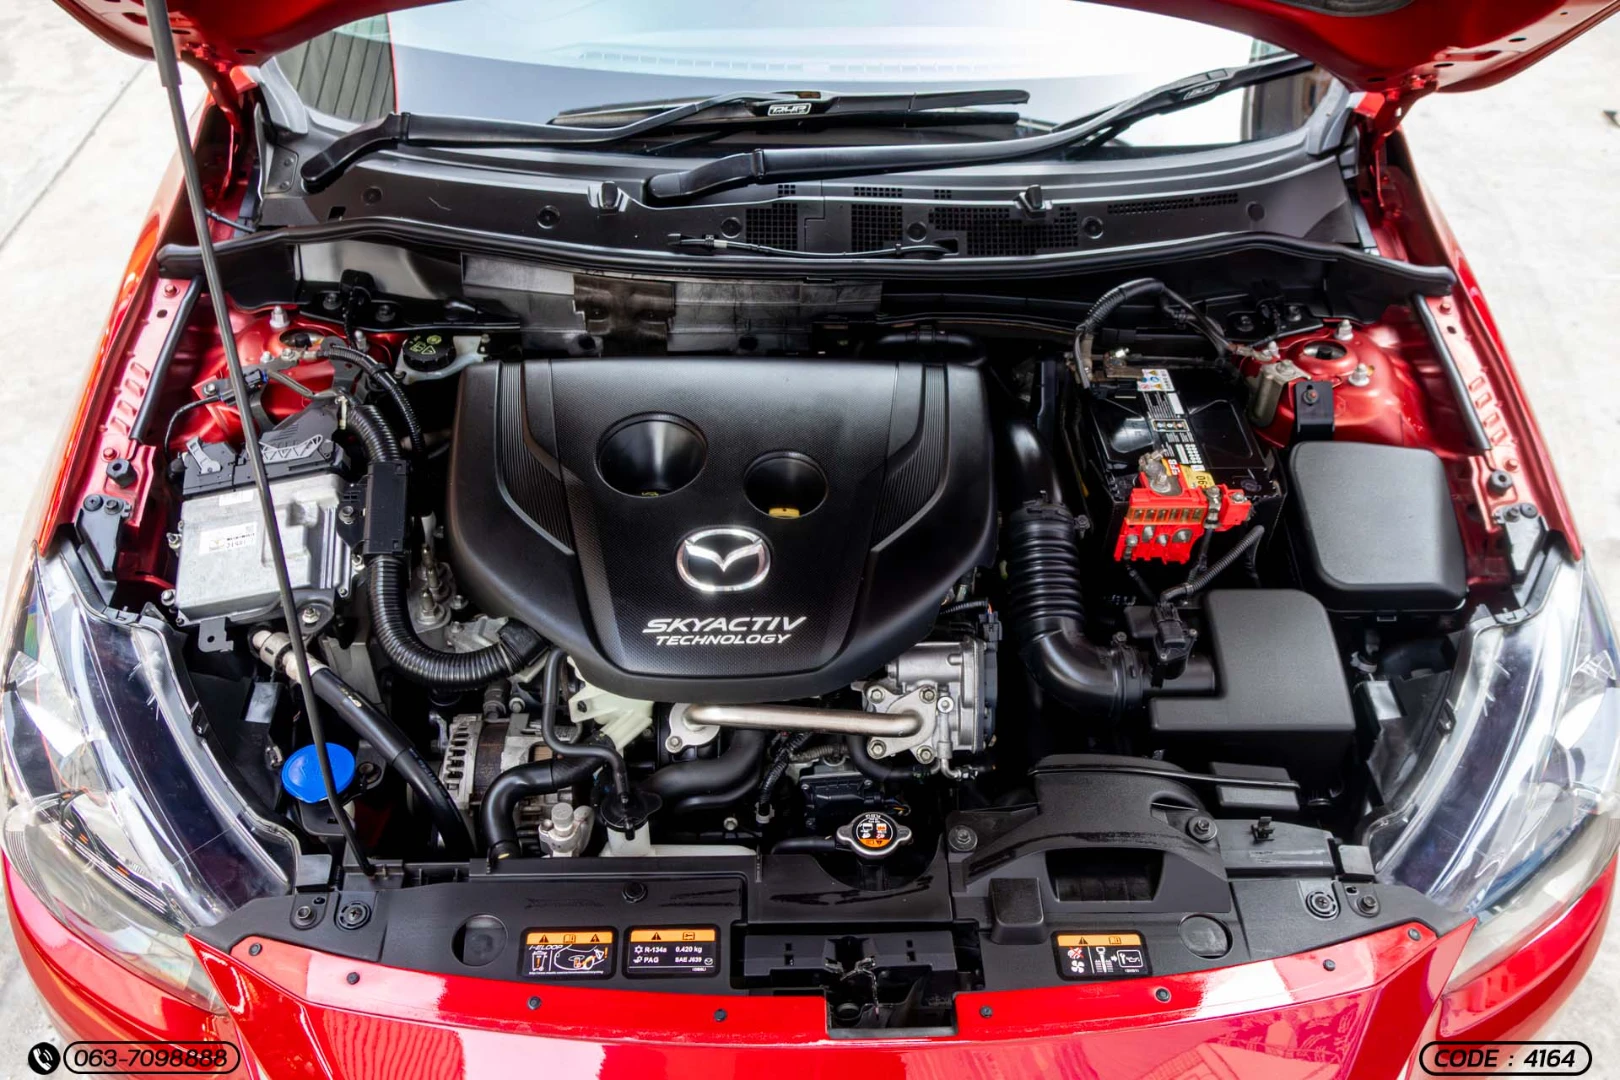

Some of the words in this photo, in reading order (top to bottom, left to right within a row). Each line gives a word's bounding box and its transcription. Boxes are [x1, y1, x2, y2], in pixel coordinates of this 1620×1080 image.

[642, 616, 807, 633] SKYACTIV
[656, 634, 792, 646] TECHNOLOGY
[694, 946, 703, 954] kg
